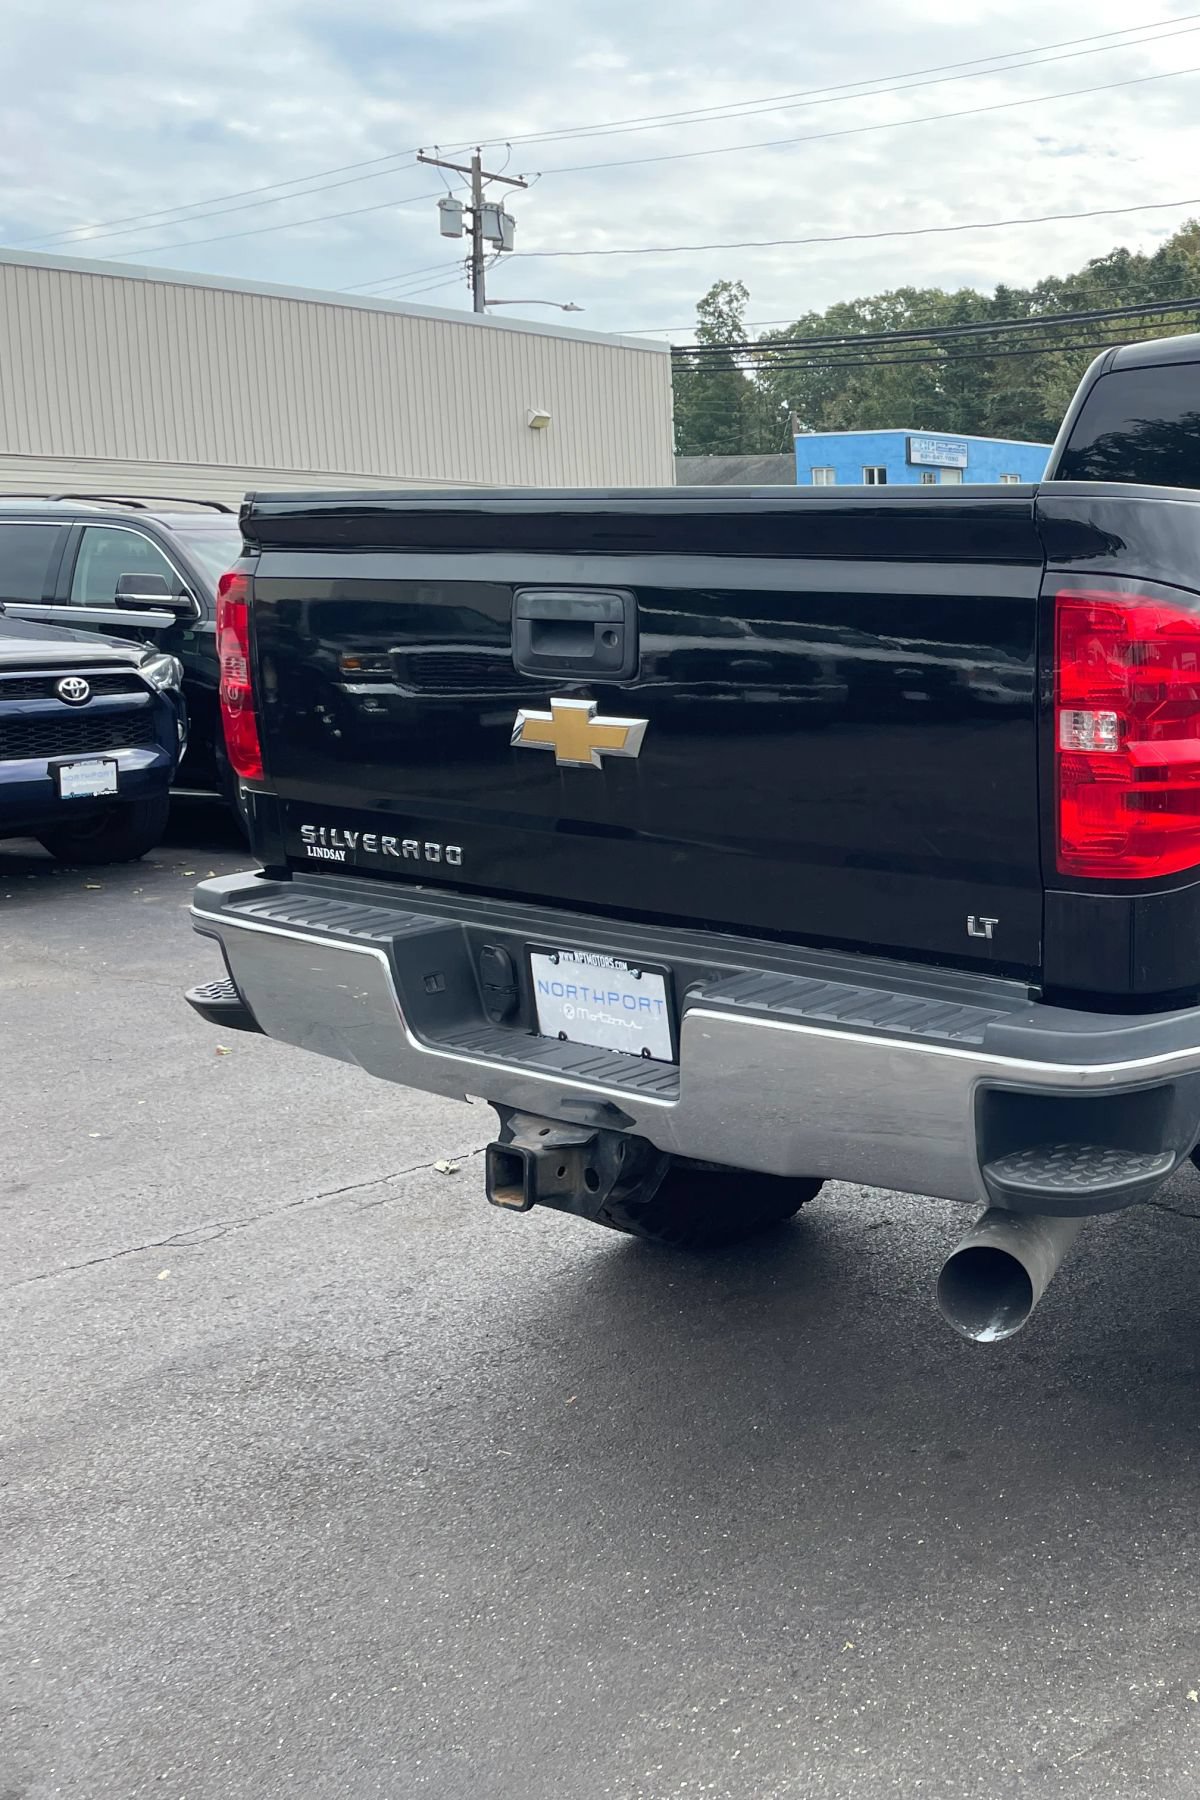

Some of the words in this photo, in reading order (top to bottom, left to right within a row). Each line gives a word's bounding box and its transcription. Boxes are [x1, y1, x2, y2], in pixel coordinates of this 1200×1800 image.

[300, 824, 464, 866] SILVERADO
[306, 845, 347, 862] LINDSAY
[967, 915, 999, 939] LT
[537, 979, 664, 1015] NORTHPORT
